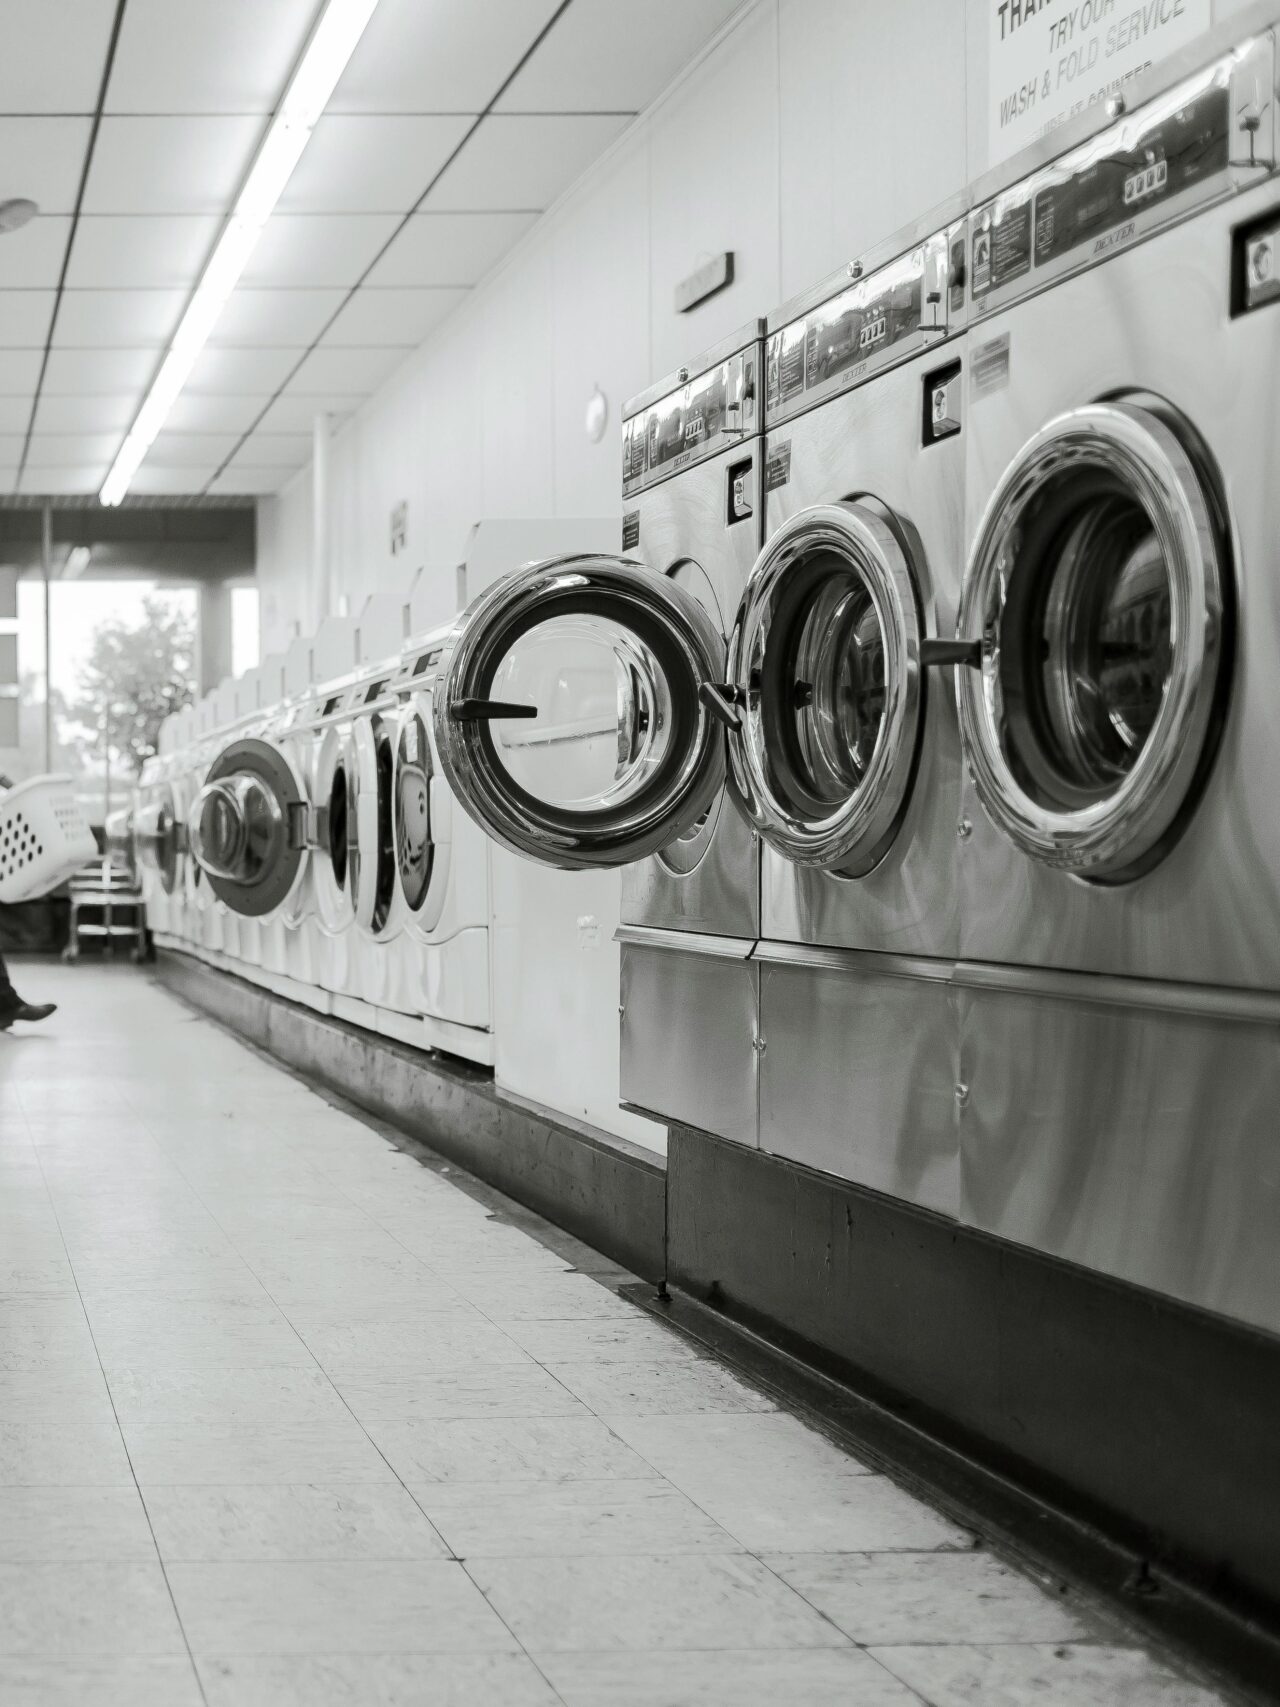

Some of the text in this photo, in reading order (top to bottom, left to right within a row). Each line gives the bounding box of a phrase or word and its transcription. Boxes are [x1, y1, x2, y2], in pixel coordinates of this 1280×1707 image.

[1049, 7, 1079, 53] TRY
[1000, 0, 1185, 128] WASH & FOLD SERVICE
[1093, 222, 1136, 254] DEXTER
